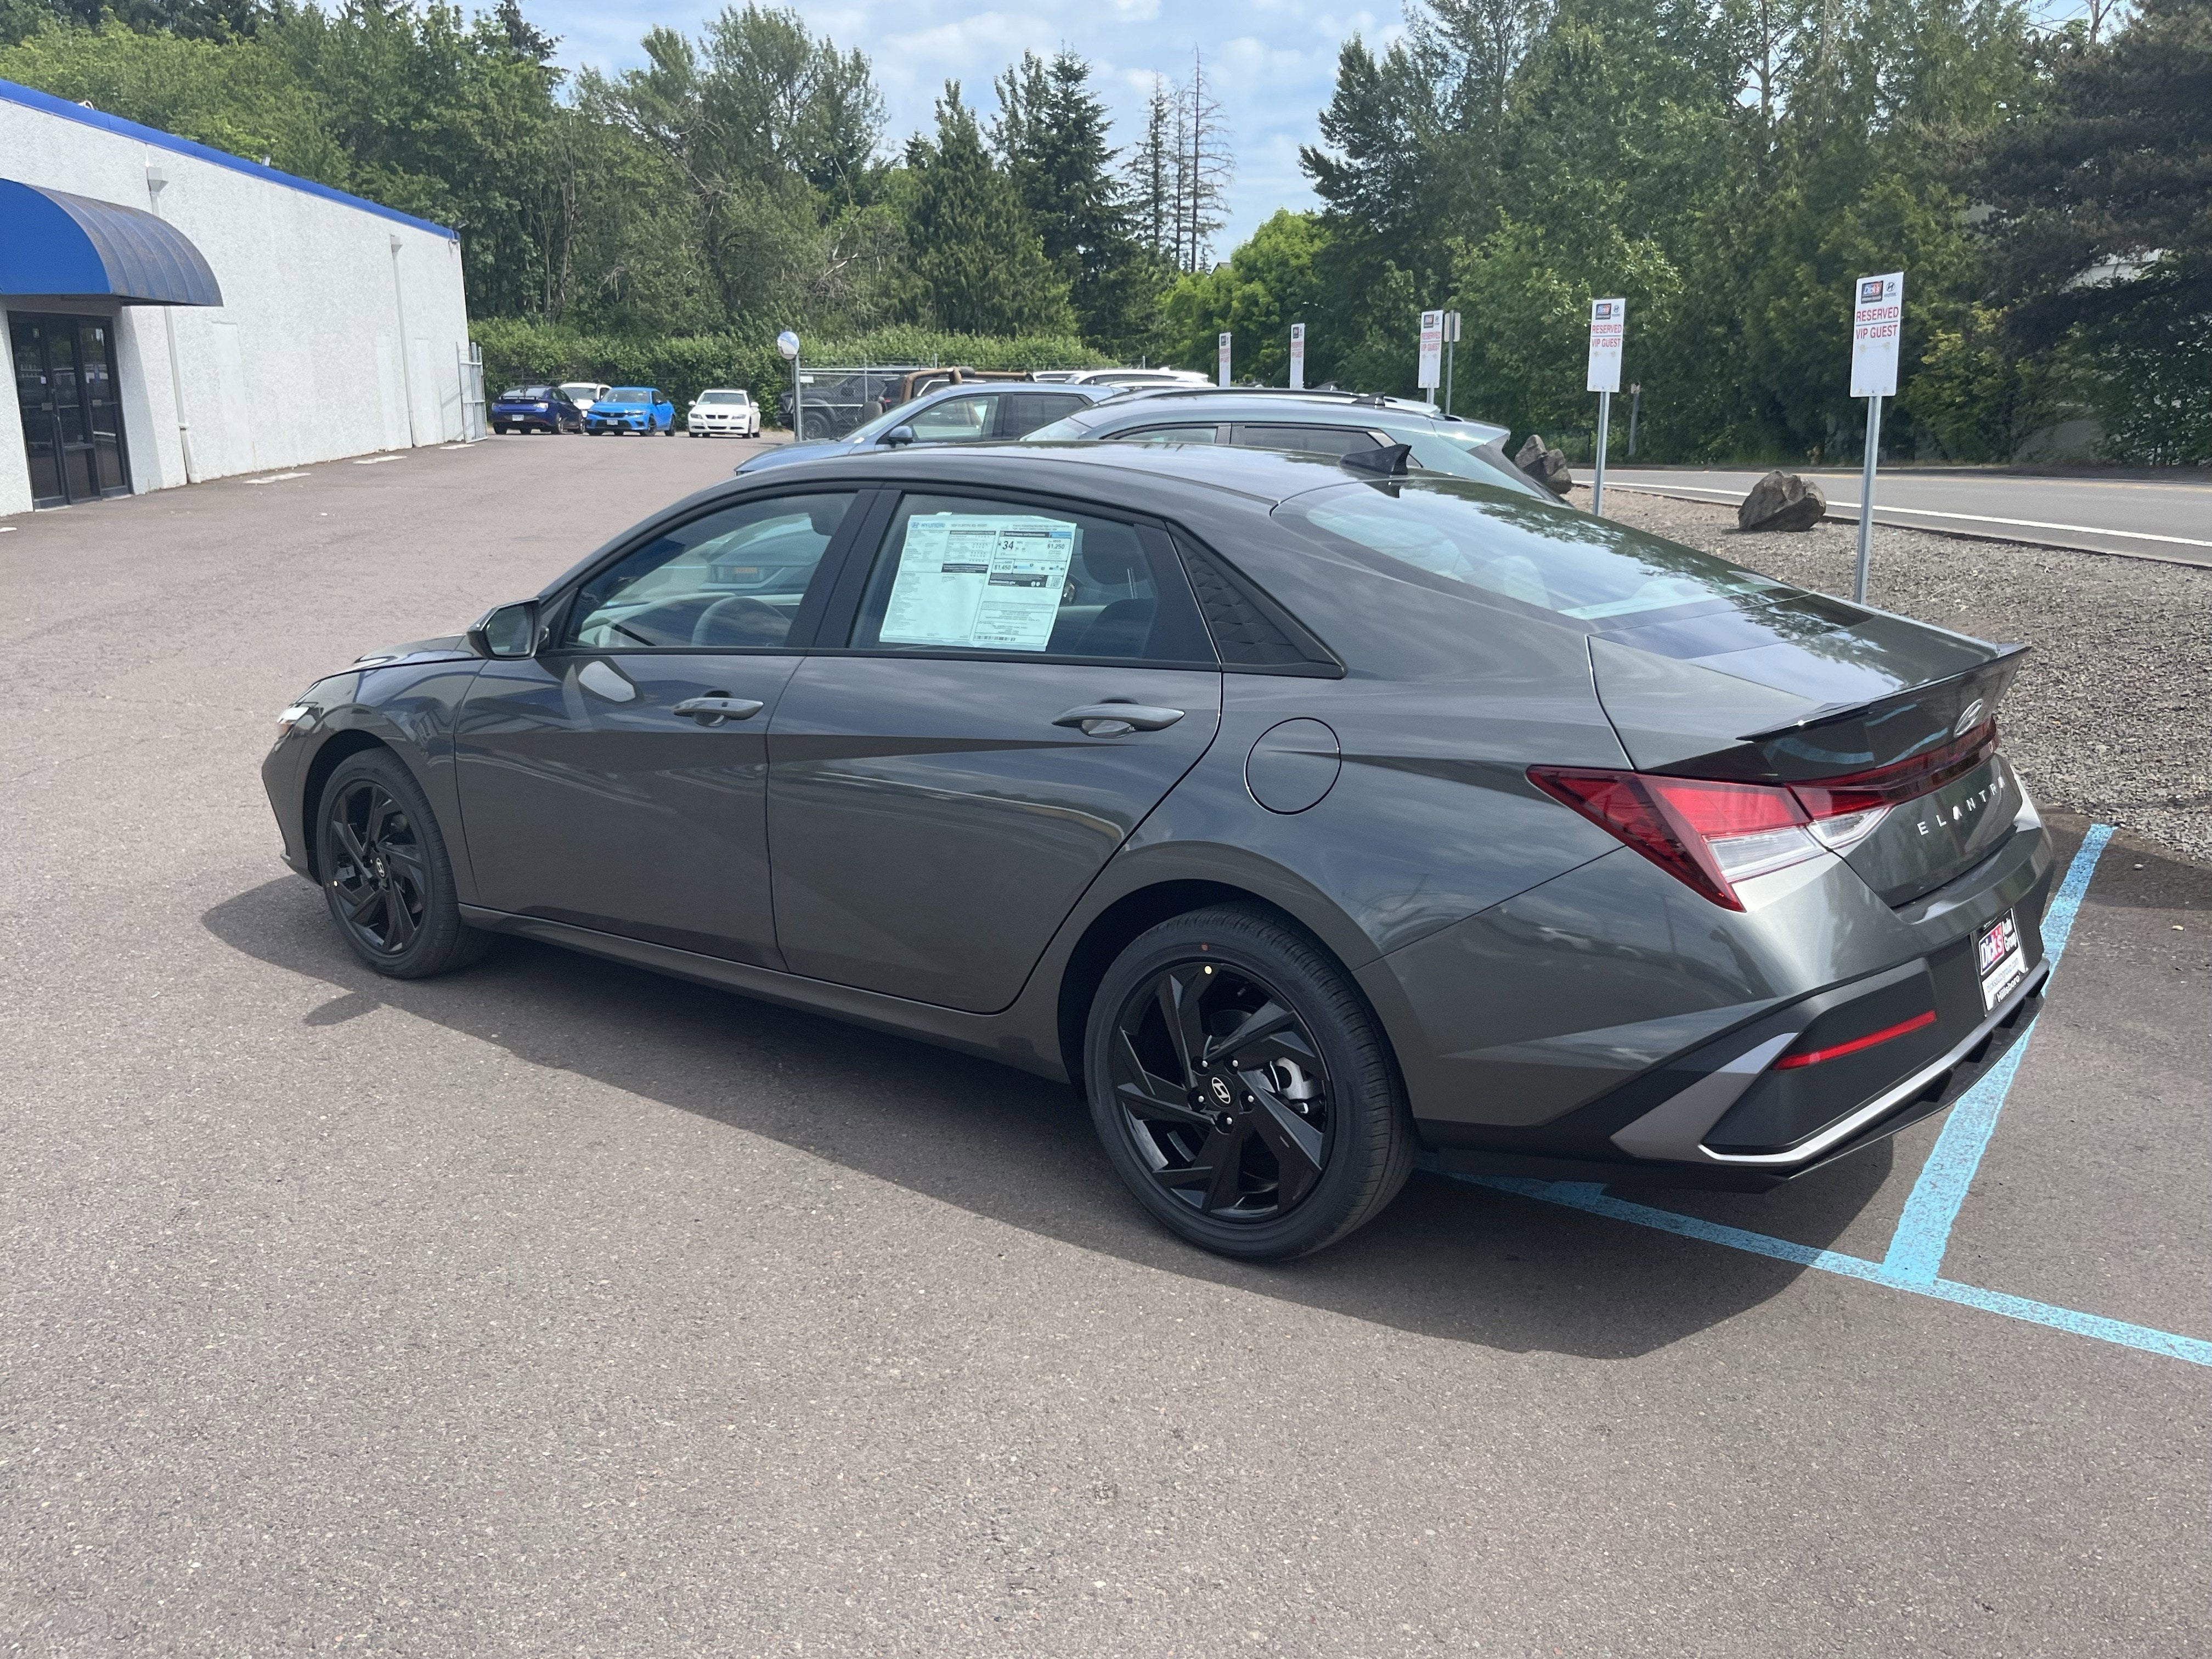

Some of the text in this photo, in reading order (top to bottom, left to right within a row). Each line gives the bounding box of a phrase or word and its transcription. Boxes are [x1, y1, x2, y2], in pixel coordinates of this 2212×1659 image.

[1856, 306, 1899, 322] RESERVED
[1592, 324, 1622, 334] RESERVED
[1855, 325, 1898, 340] VIP GUEST
[1592, 338, 1621, 348] VIP GUEST
[1002, 540, 1014, 550] 34
[1917, 776, 2005, 836] ELANTRA
[1980, 929, 2002, 967] Dick's
[1997, 975, 2020, 1003] Hillsboro
